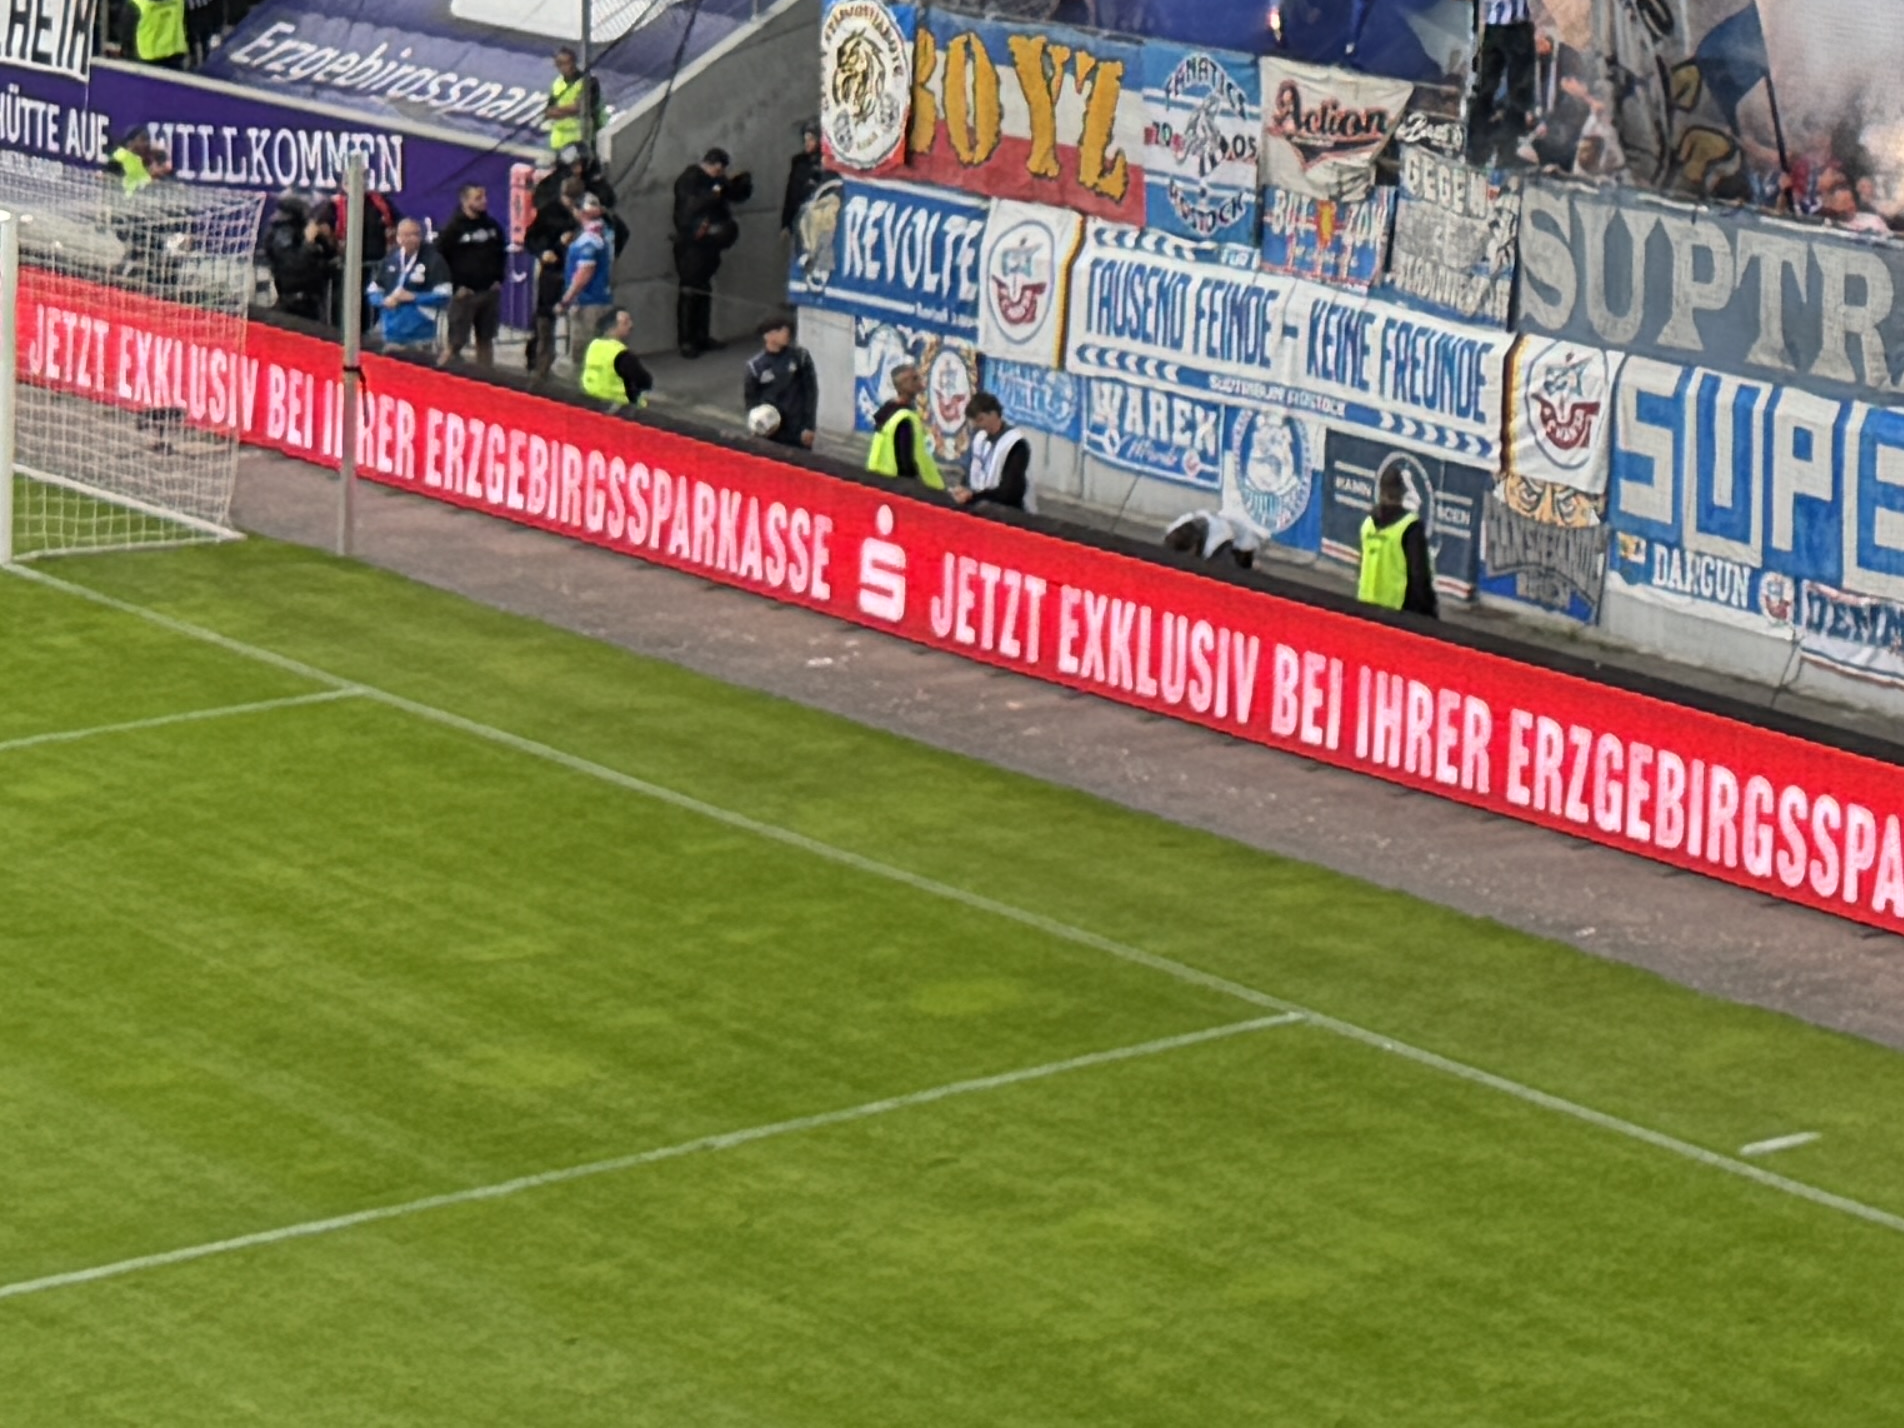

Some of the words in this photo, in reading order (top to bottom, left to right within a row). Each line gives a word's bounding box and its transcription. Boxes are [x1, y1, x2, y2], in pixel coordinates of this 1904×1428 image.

[228, 20, 630, 134] Erzgebirgsspar
[1268, 79, 1389, 139] Action
[65, 107, 110, 164] AUE
[842, 195, 985, 302] REVOLTE
[1087, 256, 1192, 350] TAUSEND
[1195, 277, 1281, 369] FEINDE
[1307, 298, 1377, 392] KEINE
[1380, 316, 1494, 424] FREUNDE
[29, 304, 111, 393] JETZT
[117, 324, 259, 432] EXKLUSIV
[267, 363, 315, 449] BEI
[423, 407, 834, 602] ERZGEBIRGSSPARKASSE
[930, 551, 1048, 664] JETZT
[1055, 583, 1261, 726] EXKLUSIV
[1270, 642, 1344, 751] BEI
[1355, 665, 1493, 795] IHRER
[1651, 542, 1751, 609] DARGUN
